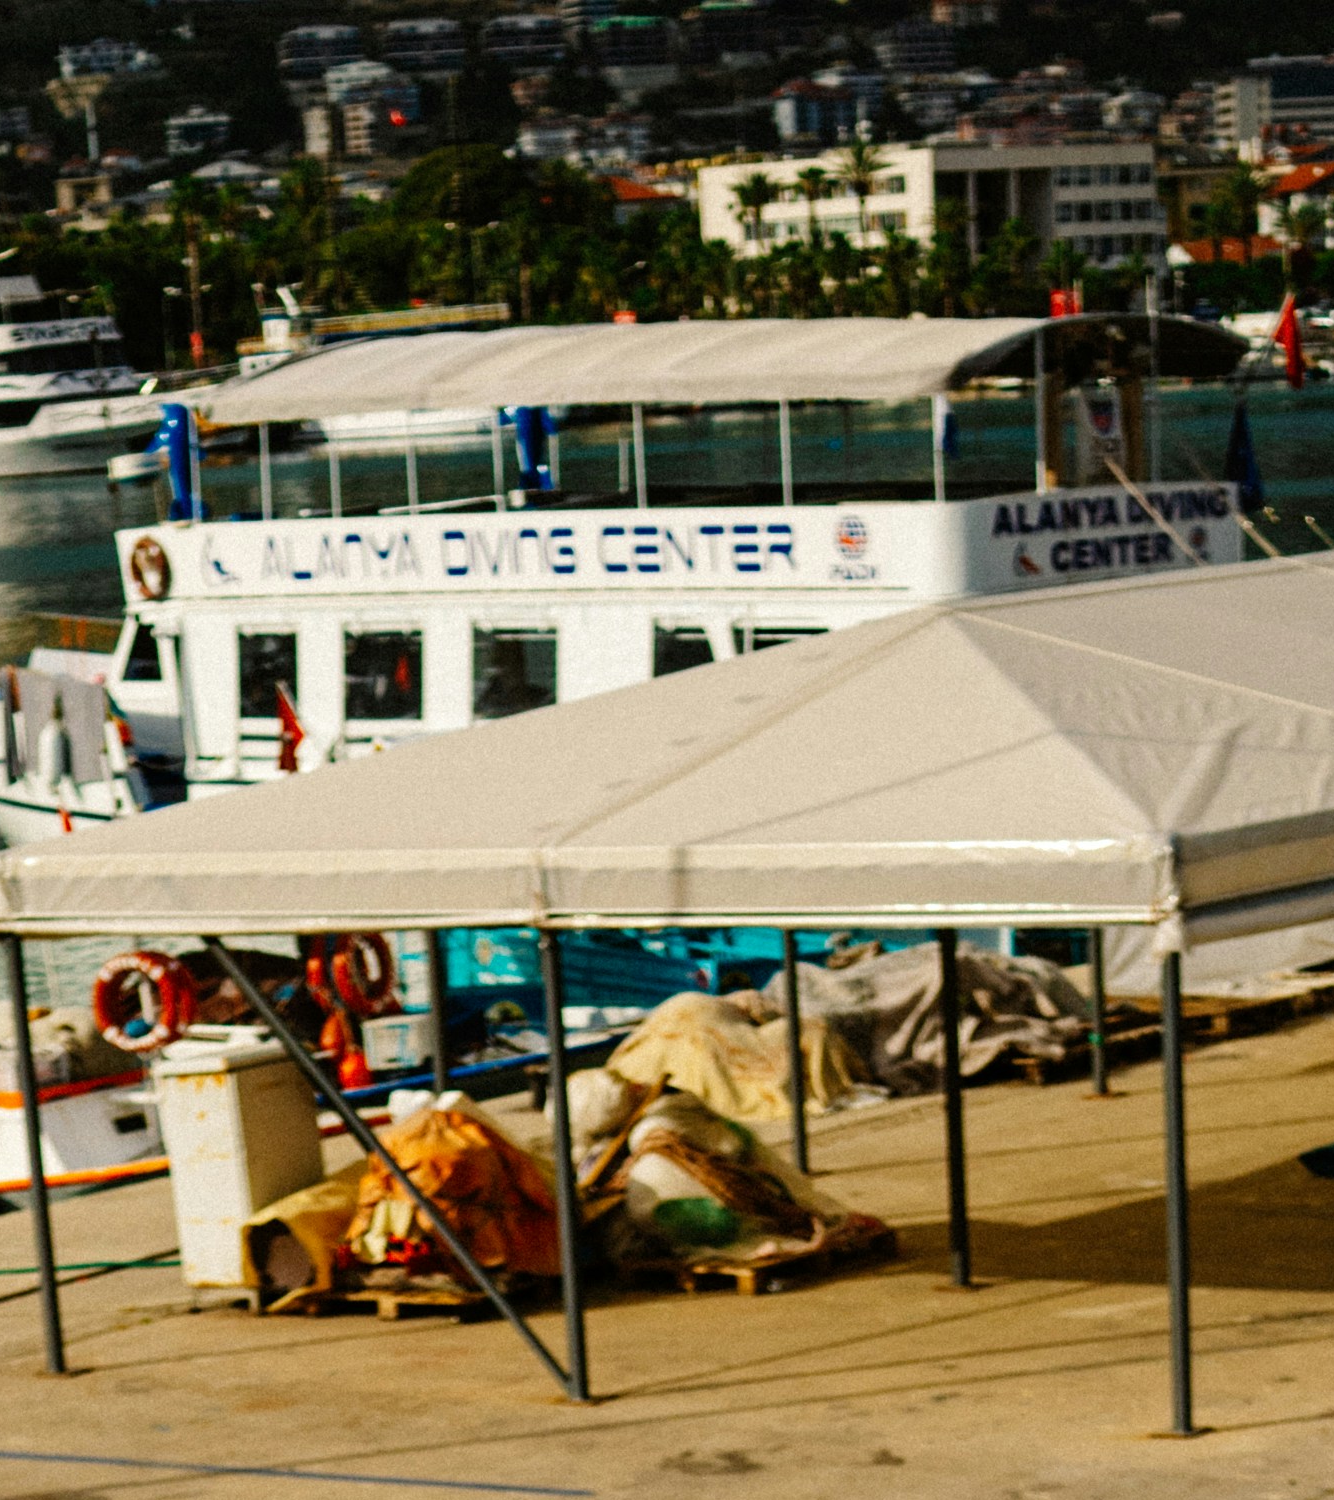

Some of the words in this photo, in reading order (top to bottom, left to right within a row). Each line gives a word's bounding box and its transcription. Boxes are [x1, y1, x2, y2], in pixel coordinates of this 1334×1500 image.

[992, 497, 1118, 537] ALANYA
[1127, 486, 1229, 525] DIVING
[260, 530, 421, 580] ALANYA
[441, 528, 577, 577] DIVING
[598, 523, 795, 574] CENTER
[1050, 531, 1175, 572] CENTER
